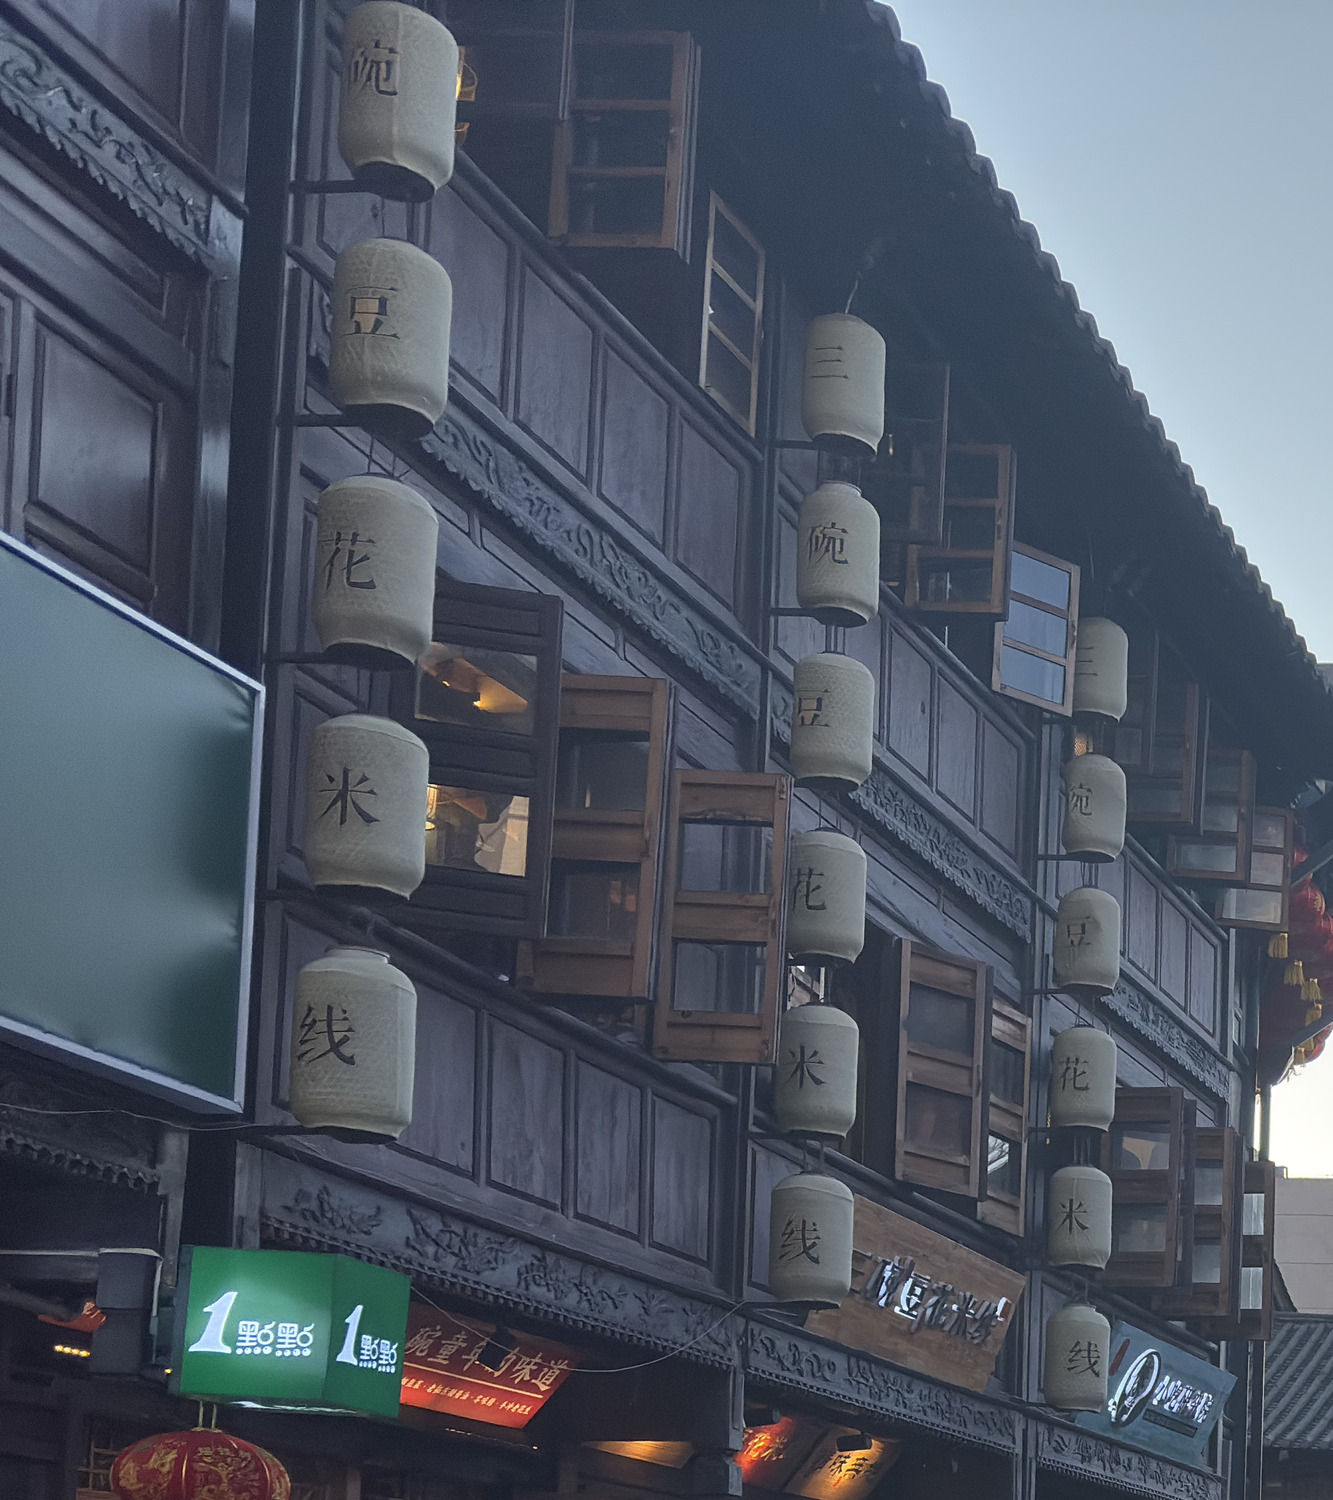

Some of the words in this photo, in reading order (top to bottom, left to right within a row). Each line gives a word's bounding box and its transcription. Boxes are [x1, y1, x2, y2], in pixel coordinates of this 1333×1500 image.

[344, 286, 400, 339] 豆
[811, 345, 850, 380] 三
[322, 530, 377, 590] 花
[806, 521, 850, 567] 碗
[317, 767, 380, 826] 米
[790, 867, 826, 912] 花
[1066, 916, 1093, 948] 豆
[297, 1003, 356, 1066] 线
[786, 1045, 826, 1087] 米
[1059, 1056, 1090, 1094] 花
[1058, 1197, 1090, 1236] 米
[780, 1217, 822, 1265] 线
[1067, 1339, 1101, 1377] 线
